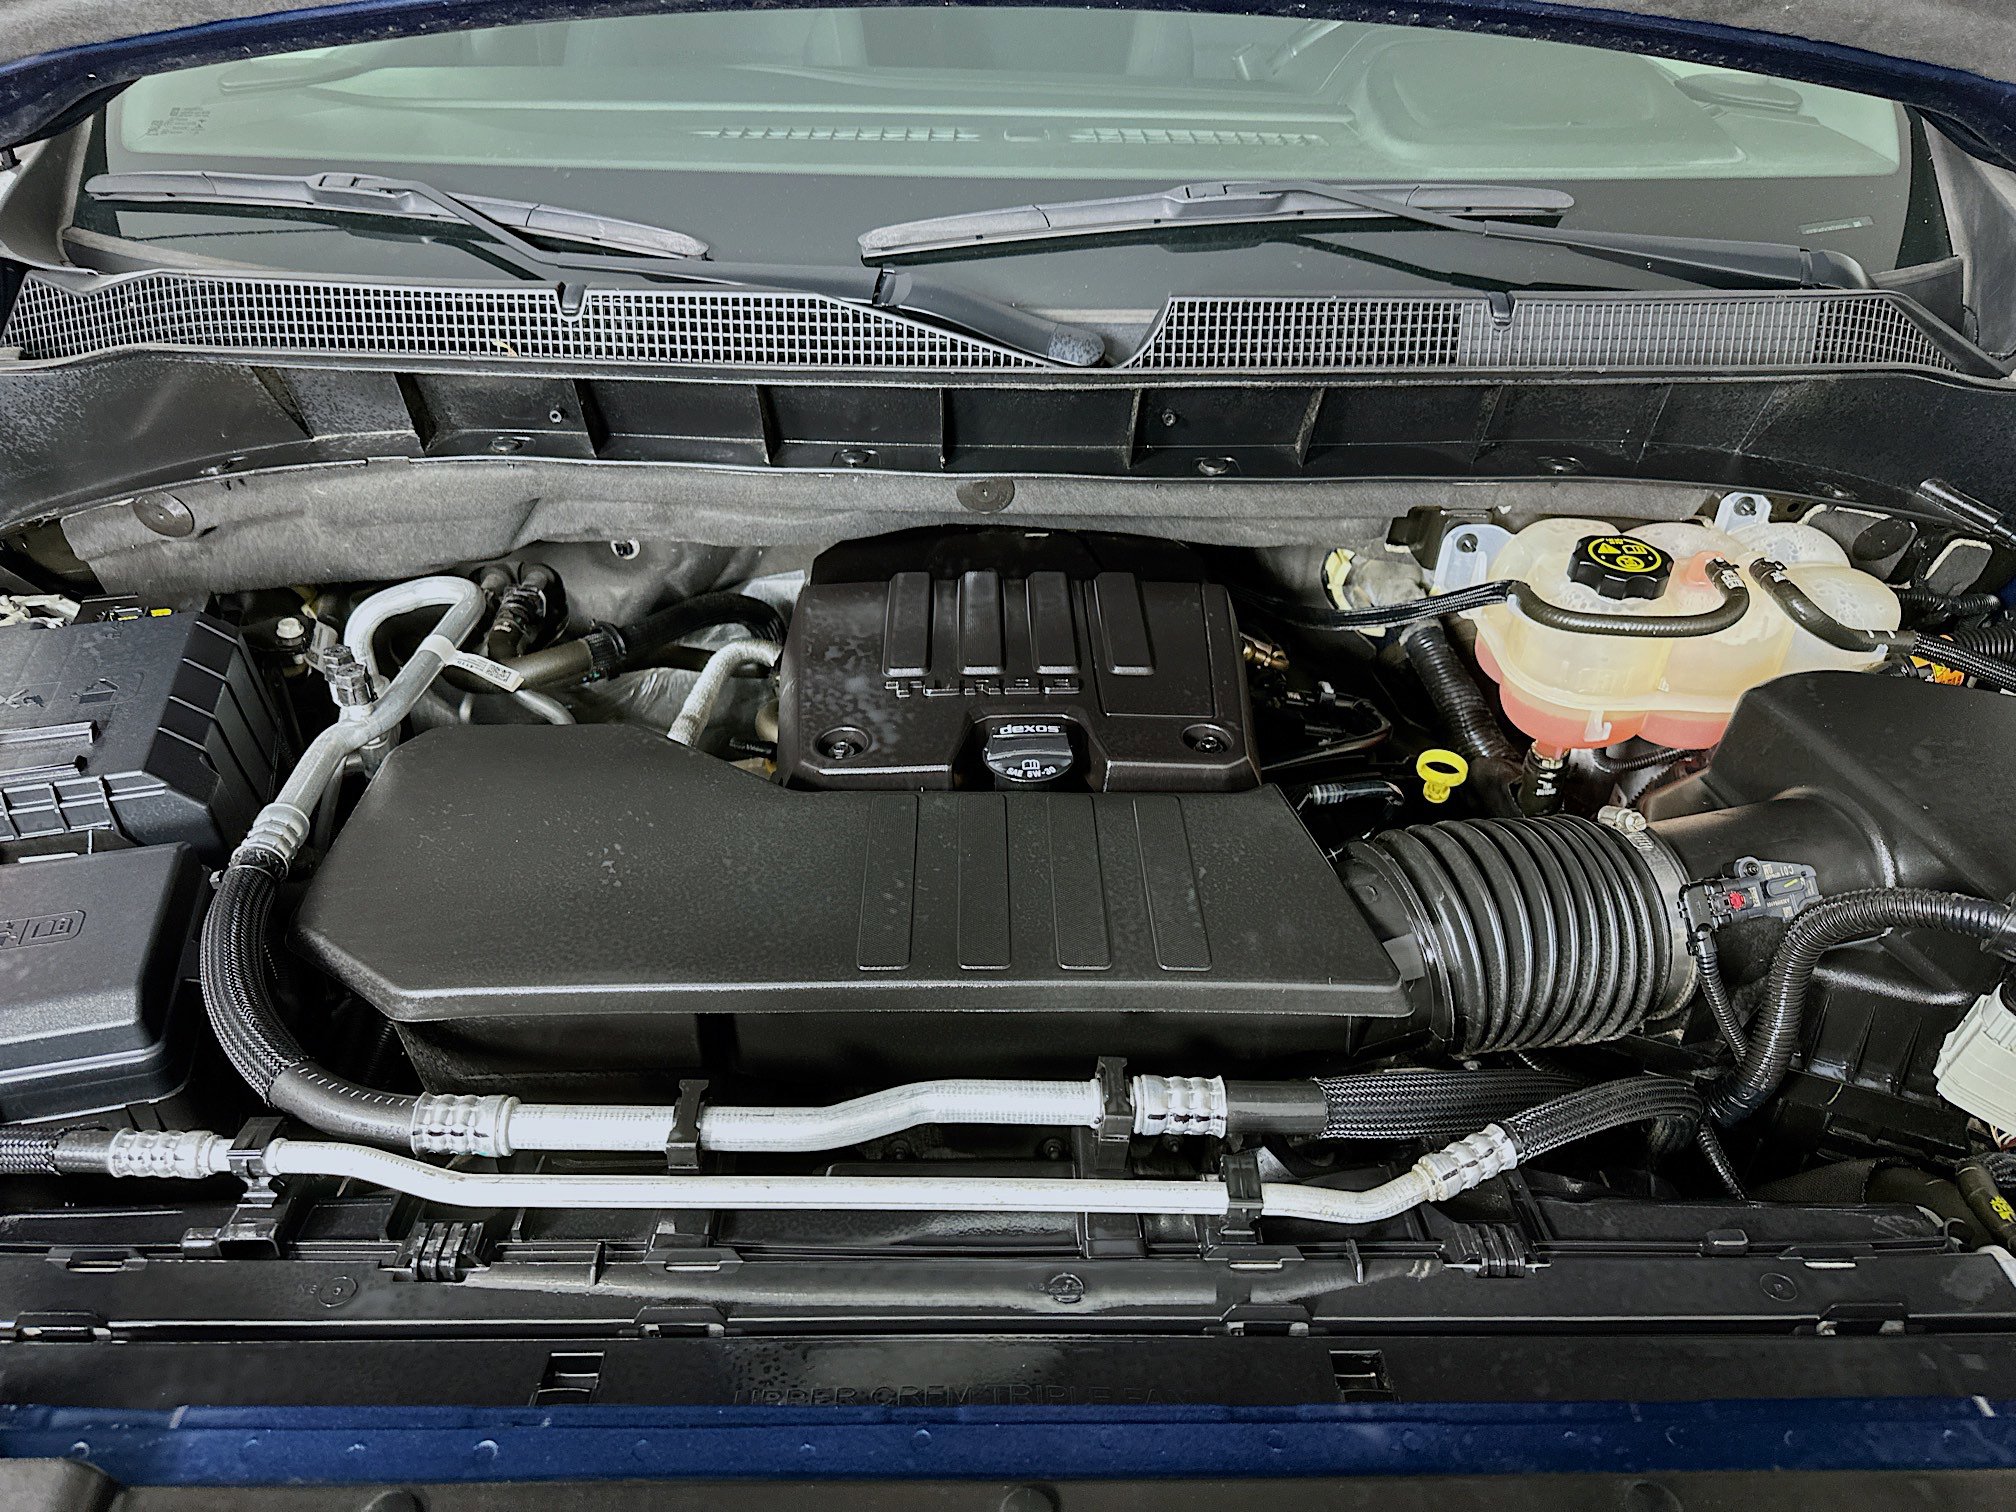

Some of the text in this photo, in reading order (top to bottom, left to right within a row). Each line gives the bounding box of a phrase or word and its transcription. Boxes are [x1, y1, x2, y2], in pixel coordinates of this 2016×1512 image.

[999, 724, 1061, 735] dexos
[1006, 765, 1057, 779] SAE 5W-30
